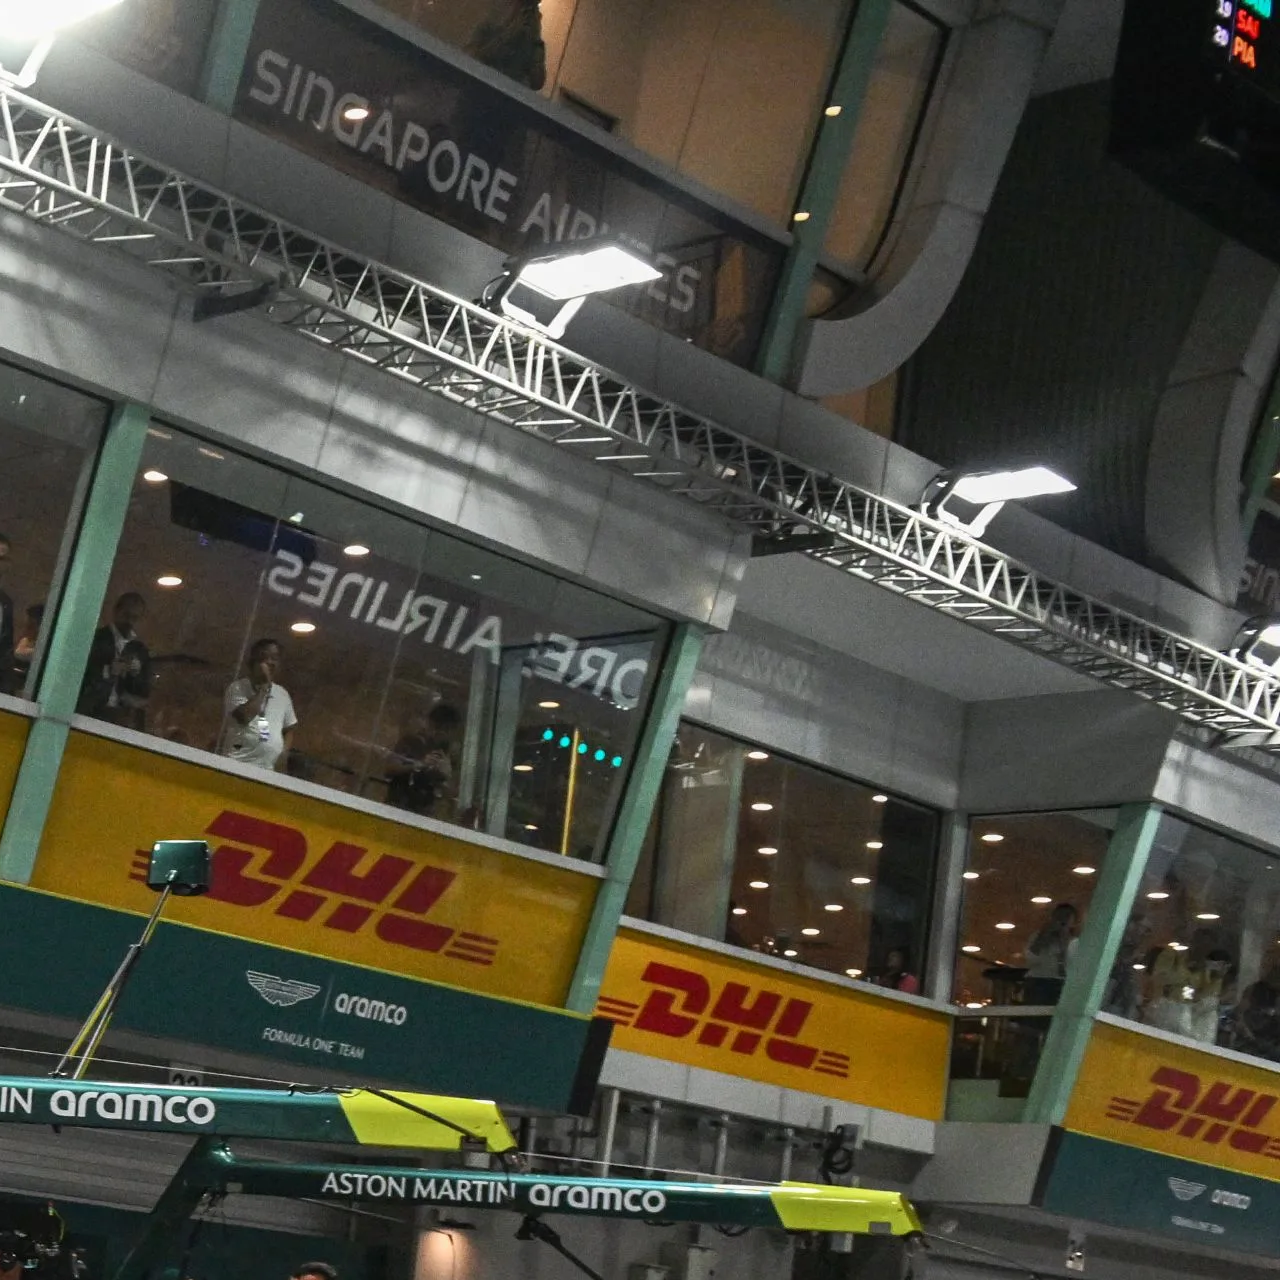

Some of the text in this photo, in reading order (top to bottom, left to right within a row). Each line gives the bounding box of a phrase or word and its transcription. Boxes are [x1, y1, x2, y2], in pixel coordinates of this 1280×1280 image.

[520, 192, 701, 313] AIRES
[203, 809, 460, 953] DHL
[262, 1027, 311, 1050] FORMULA
[334, 993, 408, 1026] aramco
[630, 961, 823, 1066] DHL
[49, 1089, 216, 1126] aramco
[1132, 1066, 1279, 1154] DHL
[321, 1172, 667, 1214] ASTON MARTIN aramco
